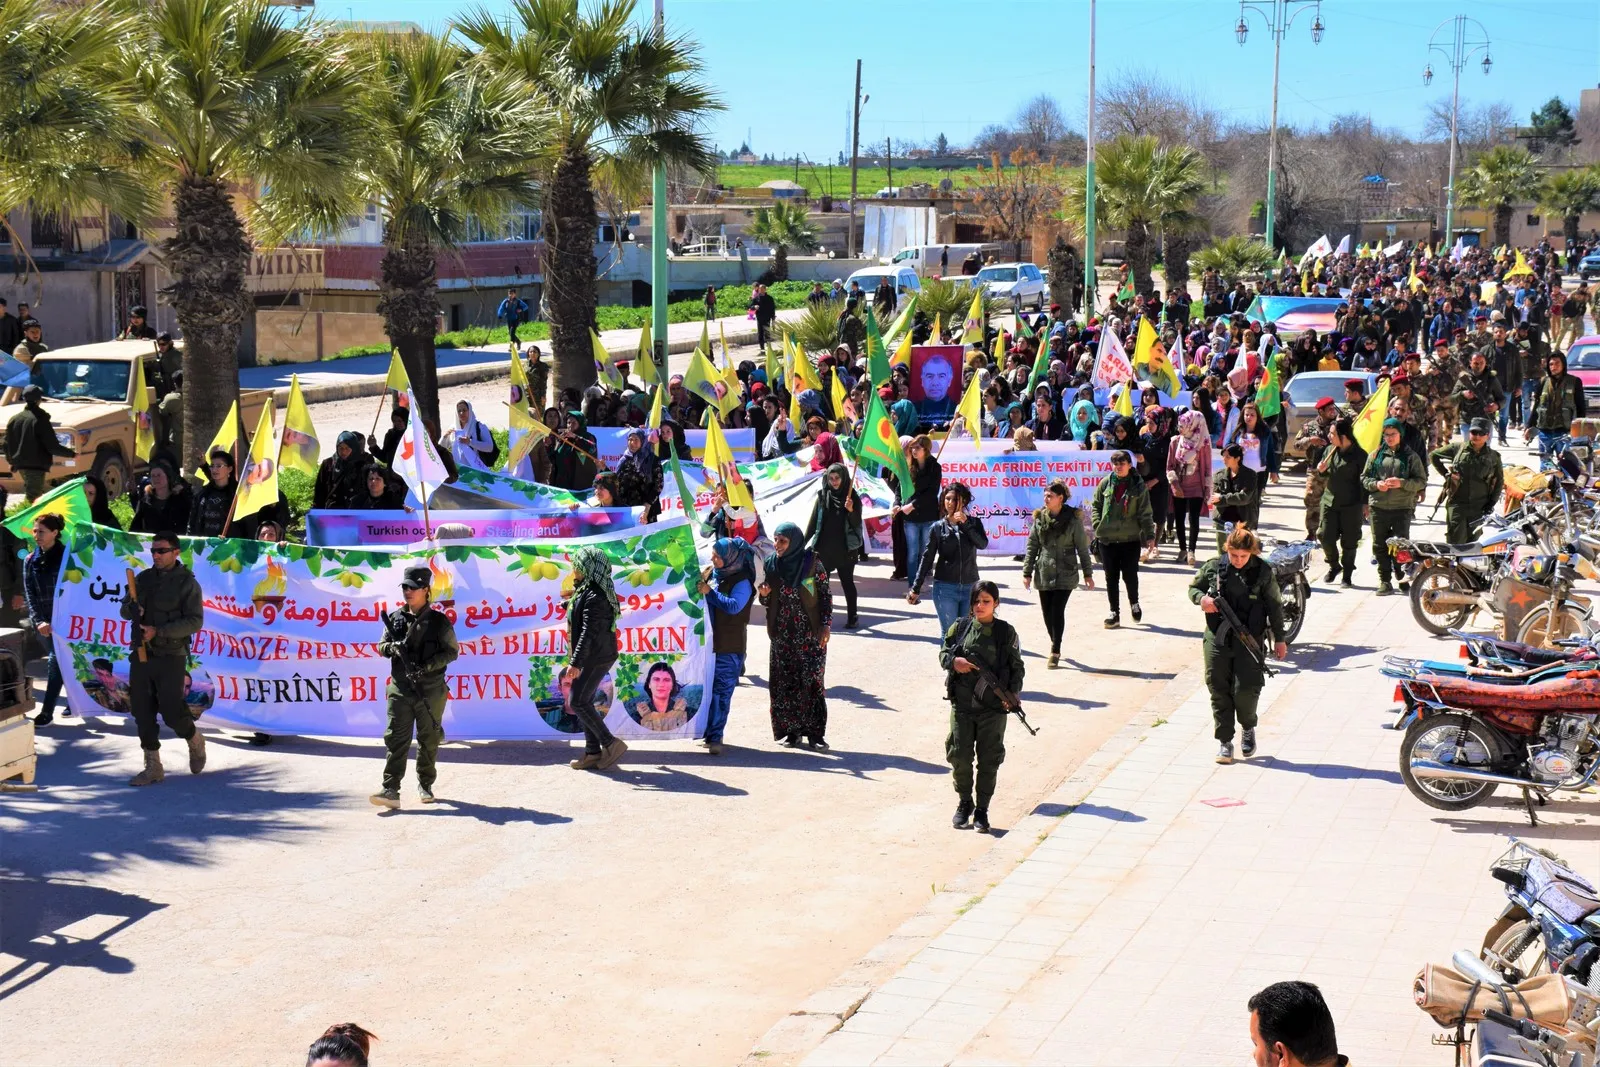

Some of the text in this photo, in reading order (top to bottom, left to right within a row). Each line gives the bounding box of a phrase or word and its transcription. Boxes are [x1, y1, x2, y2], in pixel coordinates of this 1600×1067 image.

[992, 460, 1042, 473] AFRÎNÊ
[1047, 460, 1092, 472] YEKÎTÎ
[367, 524, 409, 536] Turkish
[486, 524, 534, 539] Stealing
[537, 523, 560, 536] and
[464, 597, 537, 629] سنرفع
[66, 615, 96, 642] BI
[191, 629, 290, 661] EWROZÊ
[216, 675, 240, 701] LI
[244, 671, 343, 703] EFRÎNÊ
[349, 676, 378, 702] BI
